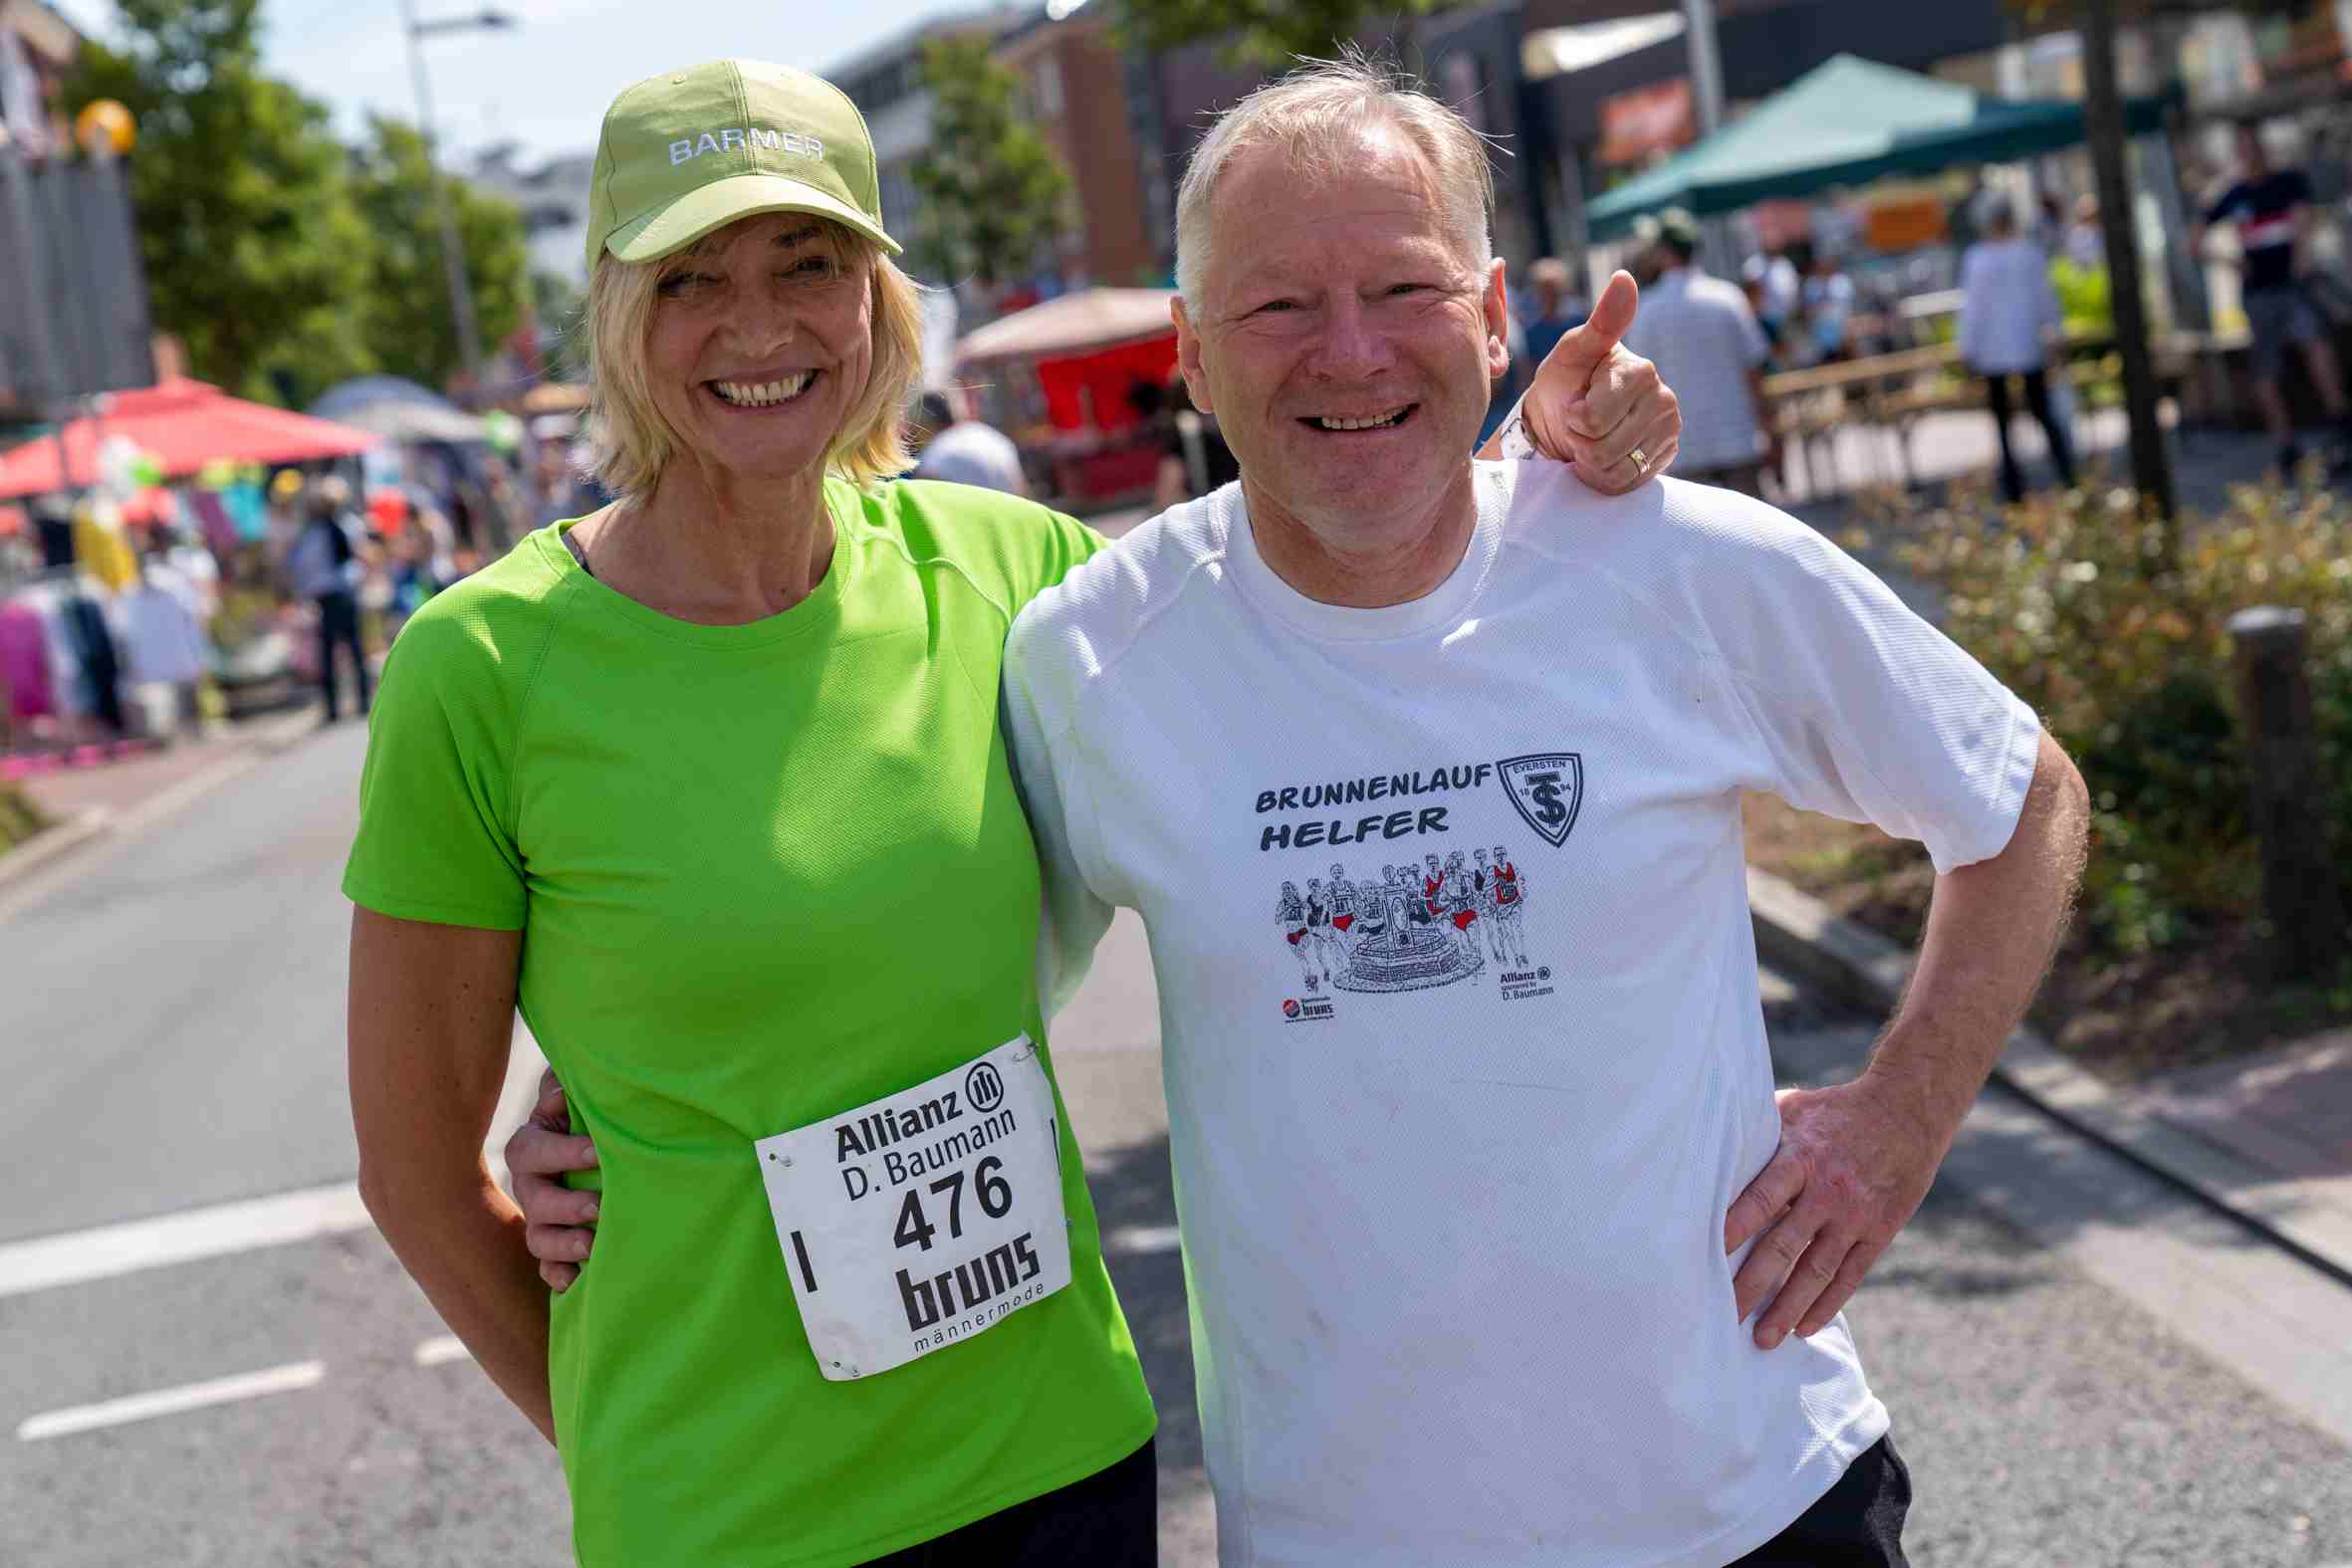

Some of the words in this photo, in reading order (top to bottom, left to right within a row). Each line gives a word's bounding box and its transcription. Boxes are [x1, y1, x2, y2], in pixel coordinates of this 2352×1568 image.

[669, 127, 824, 165] BARMER
[1255, 764, 1492, 812] BRUNNENLAUF
[1514, 760, 1566, 774] EVERSTEN
[1260, 806, 1449, 851] HELFER
[1500, 972, 1534, 984] Allianz
[834, 1091, 963, 1163] Allianz
[841, 1166, 881, 1202] D.
[883, 1108, 1017, 1186] Baumann
[893, 1155, 1013, 1251] 476
[895, 1232, 1041, 1332] bruns
[914, 1282, 1045, 1353] männermode
